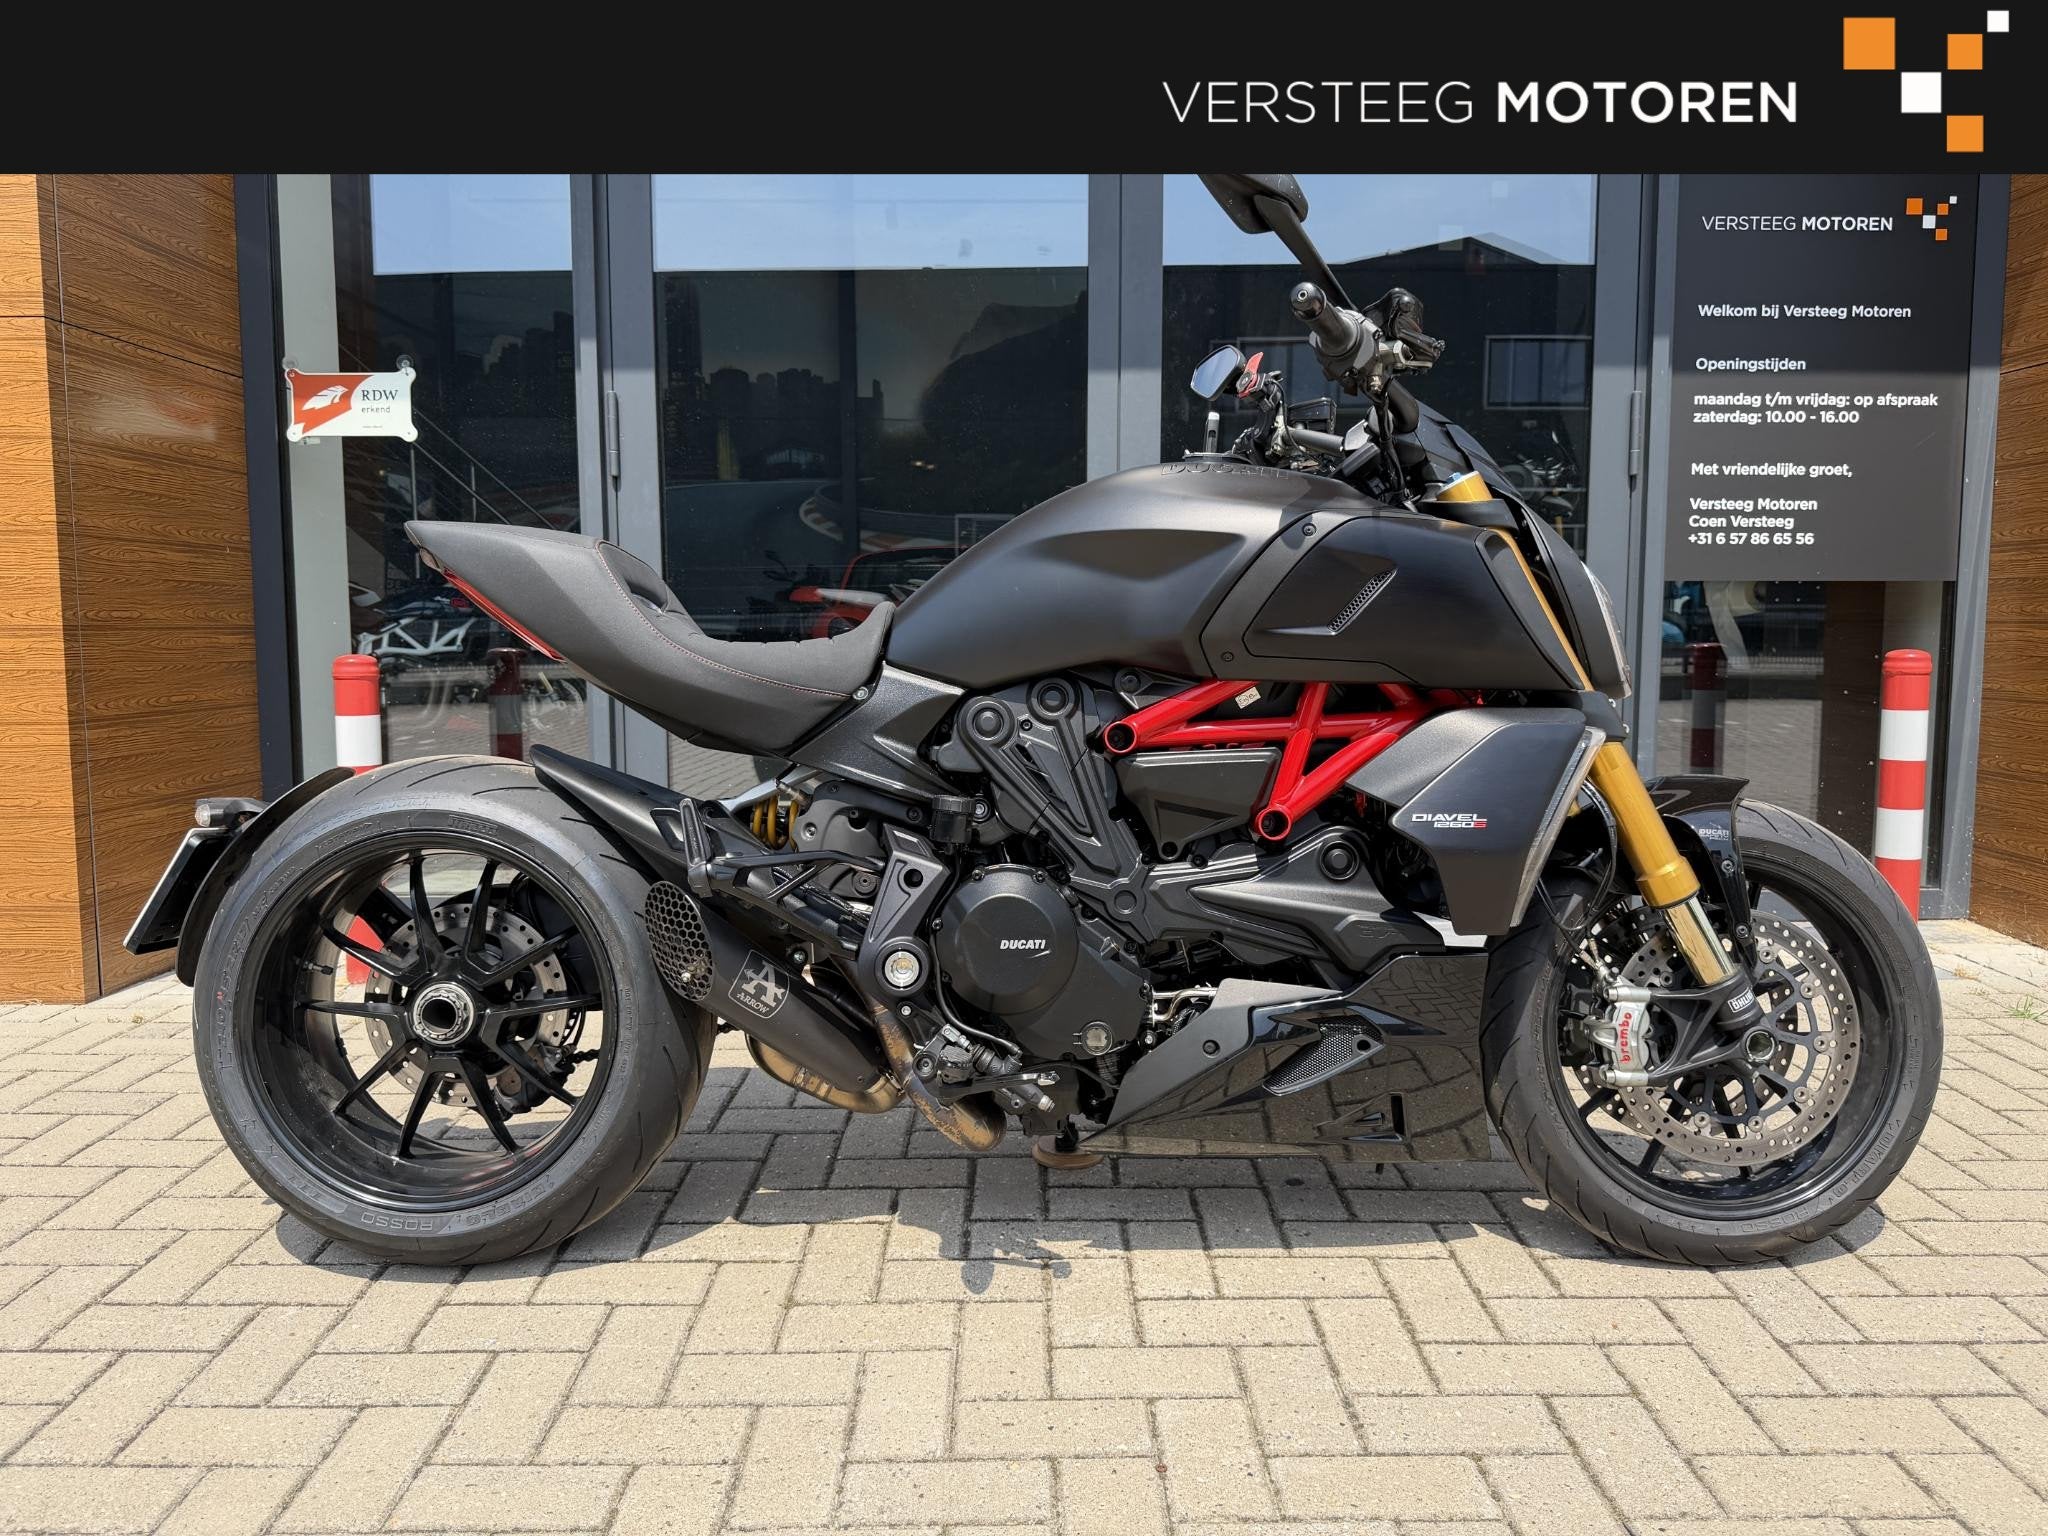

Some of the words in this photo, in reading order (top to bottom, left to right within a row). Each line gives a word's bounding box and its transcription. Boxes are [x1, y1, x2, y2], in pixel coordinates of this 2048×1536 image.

[1702, 215, 1796, 231] VERSTEEG
[1801, 216, 1893, 232] MOTOREN
[1698, 304, 1757, 318] Welkom
[1761, 304, 1780, 320] bij
[1784, 305, 1848, 320] Versteeg
[1851, 305, 1912, 319] Motoren
[1695, 357, 1807, 372] Openingstijden
[361, 389, 399, 401] RDW
[1693, 392, 1762, 407] maandag
[1764, 391, 1793, 407] t/m
[1795, 392, 1851, 408] vrijdag:
[1853, 395, 1874, 407] op
[1876, 392, 1939, 407] afspraak
[361, 405, 391, 414] erkend
[1692, 409, 1763, 425] zaterdag:
[1765, 411, 1807, 423] 10.00
[1819, 411, 1860, 423] 16.00
[1691, 463, 1720, 476] Met
[1722, 462, 1807, 478] vriendelijke
[1808, 464, 1853, 478] groet,
[1689, 497, 1755, 512] Versteeg
[1757, 498, 1818, 511] Motoren
[1688, 515, 1727, 528] Coen
[1730, 515, 1795, 529] Versteeg
[1688, 532, 1713, 545] +31
[1716, 532, 1726, 545] 6
[1729, 532, 1748, 545] 57
[1750, 532, 1770, 545] 86
[1773, 532, 1793, 545] 65
[1795, 532, 1815, 545] 56
[1411, 813, 1488, 822] DIAVEL
[1433, 821, 1488, 829] 1260S
[1698, 828, 1730, 836] DUCATI
[999, 939, 1046, 950] DUCATI
[736, 992, 770, 1014] ARROW
[1619, 1012, 1633, 1064] brembo
[360, 1210, 434, 1232] ROSSO
